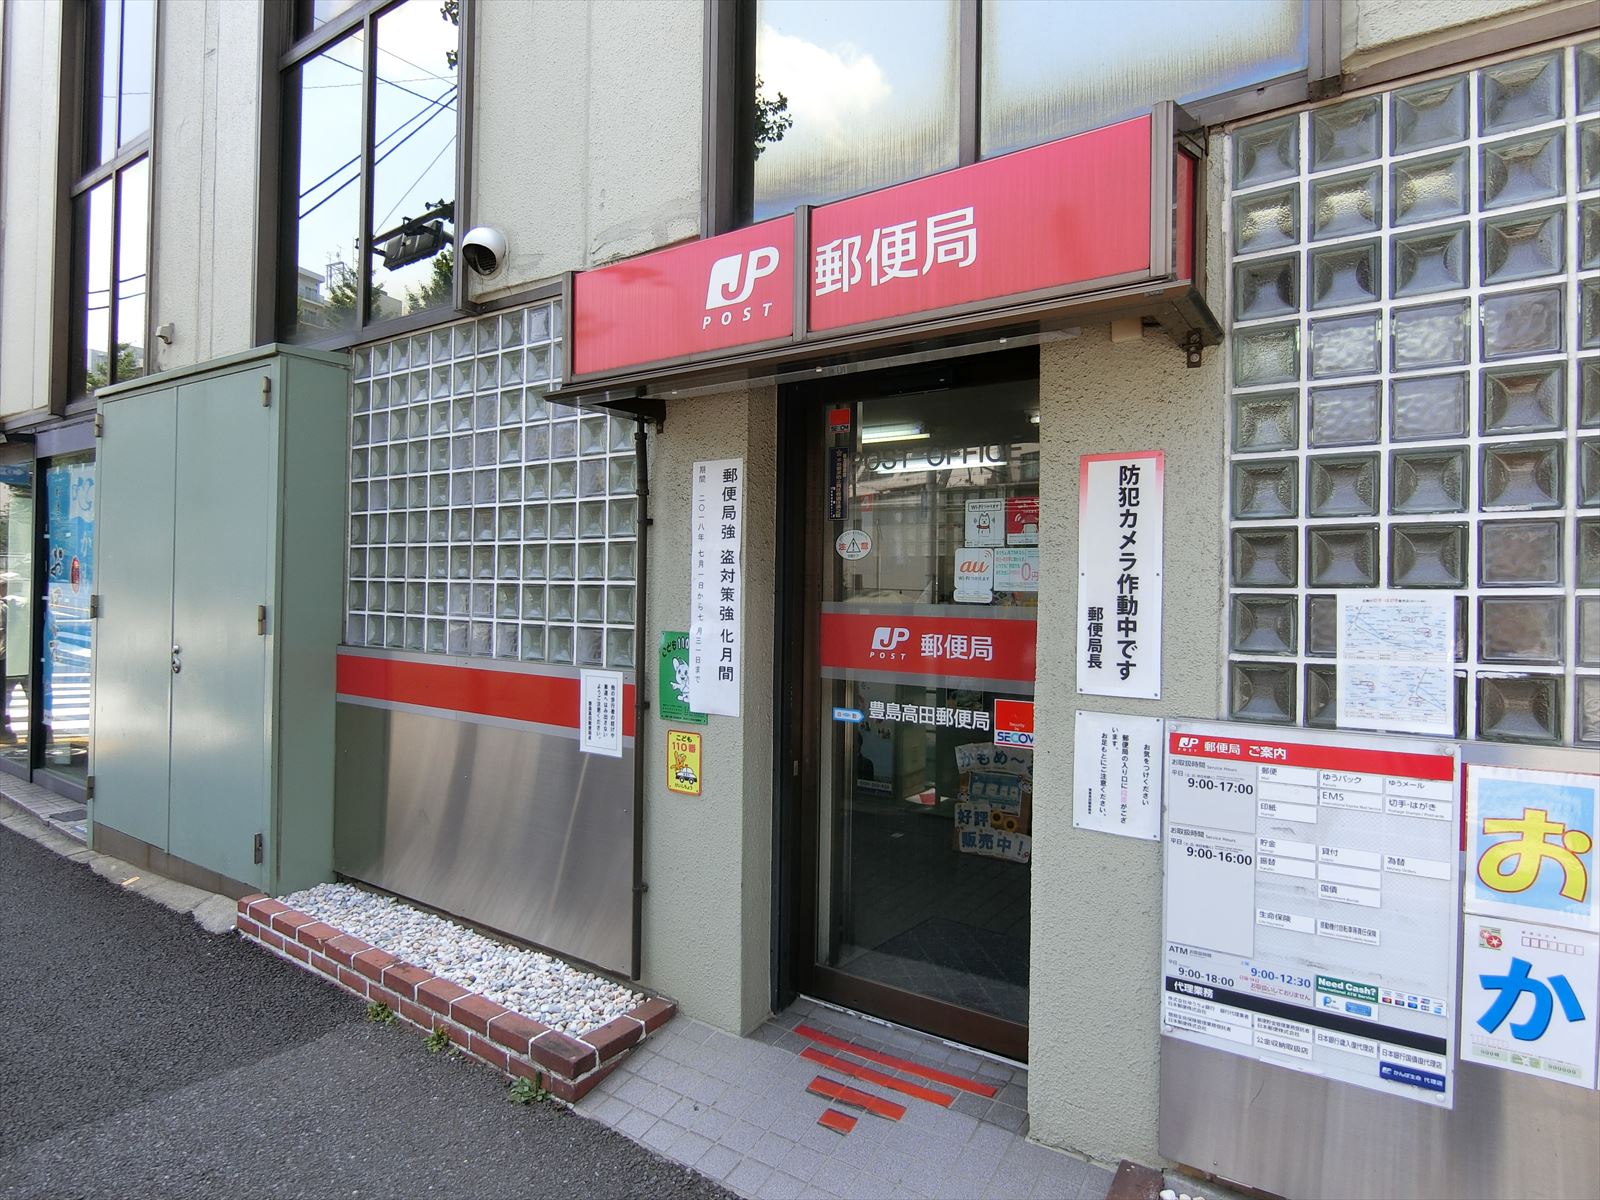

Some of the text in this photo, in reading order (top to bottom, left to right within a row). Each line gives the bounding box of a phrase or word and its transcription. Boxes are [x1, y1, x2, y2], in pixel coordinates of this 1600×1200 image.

[814, 206, 978, 297] 郵便局
[702, 302, 774, 330] POST
[718, 467, 738, 682] 郵便局強盗対策強化月間
[959, 560, 989, 573] au
[1116, 464, 1141, 681] 防犯カメラ作動中です
[1087, 606, 1104, 669] 郵便局長
[869, 651, 907, 661] POST
[920, 633, 993, 662] 郵便局
[868, 701, 990, 731] 豊島高田郵便局
[676, 734, 693, 743] こども
[1204, 741, 1287, 760] 郵便局 ご案内
[1142, 743, 1151, 806] お気をつけください
[1171, 769, 1184, 777] 平日
[1261, 766, 1278, 776] 郵便
[1322, 773, 1362, 783] ゆうパック
[1187, 777, 1254, 795] 9:00-17:00
[1388, 779, 1425, 789] ゆうメール
[1322, 791, 1345, 802] EMS
[957, 809, 989, 828] 好評
[1170, 837, 1183, 846] 平日
[1186, 846, 1252, 866] 9:00-16:00
[1476, 807, 1593, 903] お
[1259, 911, 1291, 922] 生命保険
[1168, 945, 1188, 955] ATM
[1178, 966, 1235, 988] 9:00-18:00
[1250, 967, 1311, 988] 9:00-12:30
[1318, 977, 1377, 996] Need Cash?
[1173, 981, 1214, 999] 代理業務
[1476, 956, 1586, 1042] か
